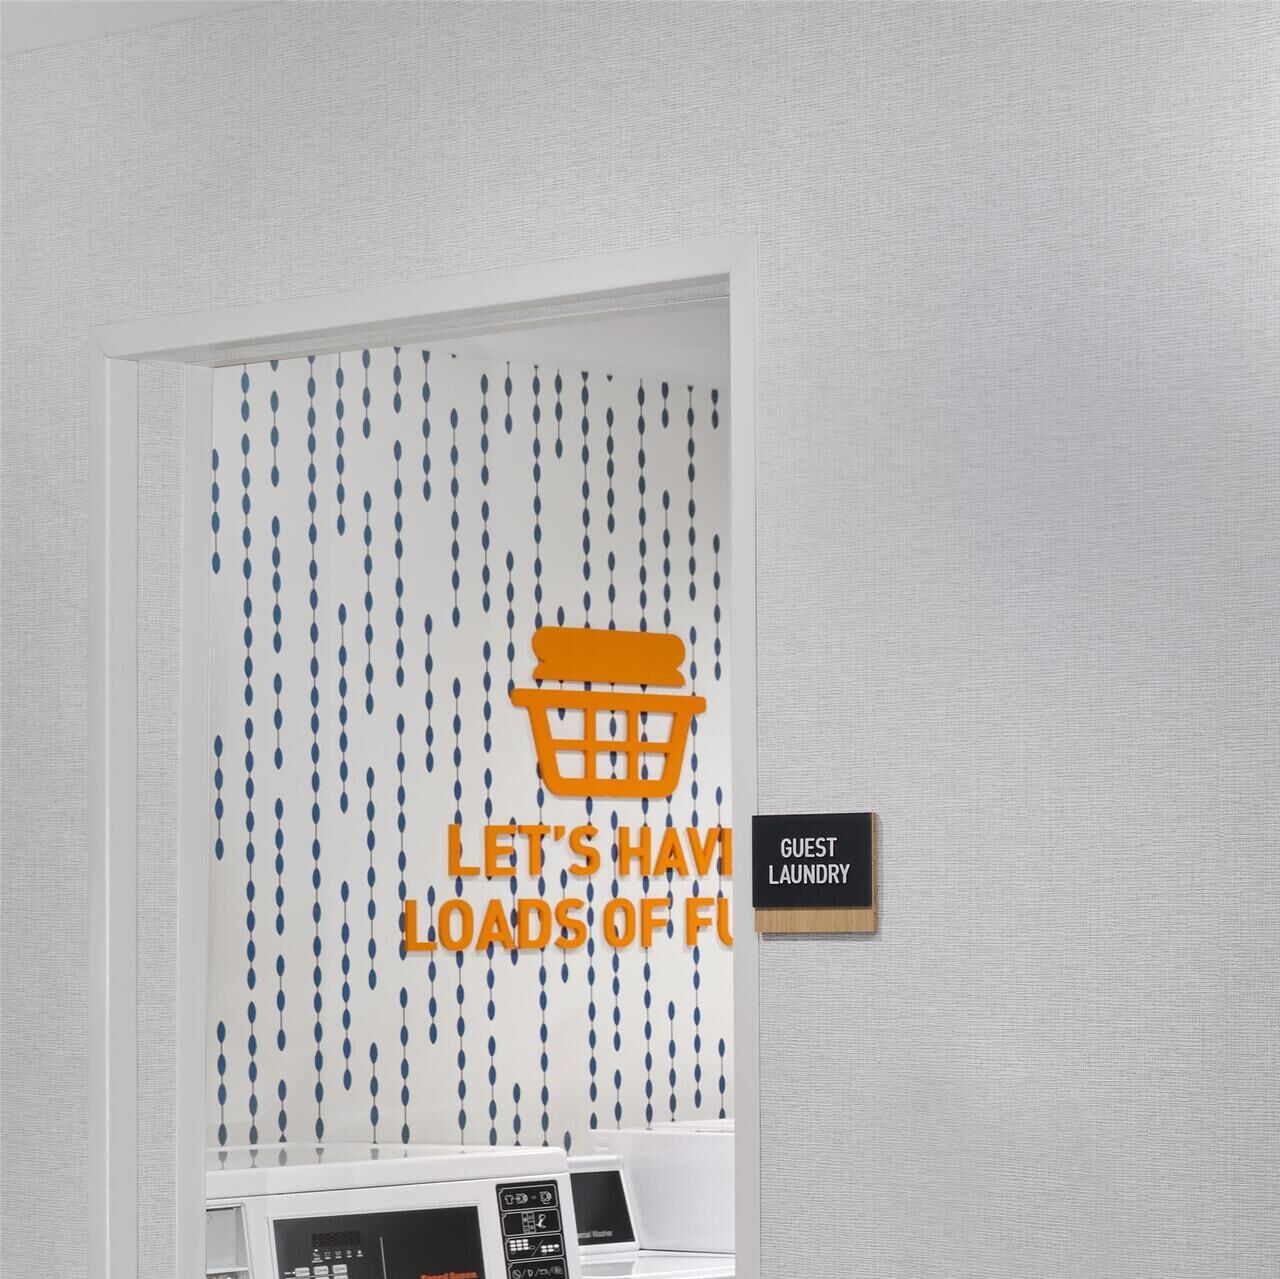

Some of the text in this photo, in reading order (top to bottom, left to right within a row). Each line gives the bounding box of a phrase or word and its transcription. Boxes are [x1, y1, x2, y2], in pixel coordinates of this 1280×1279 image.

[448, 823, 601, 877] LET'S
[780, 837, 837, 858] GUEST
[768, 863, 851, 885] LAUNDRY
[403, 897, 588, 953] LOADS
[602, 898, 671, 949] OF
